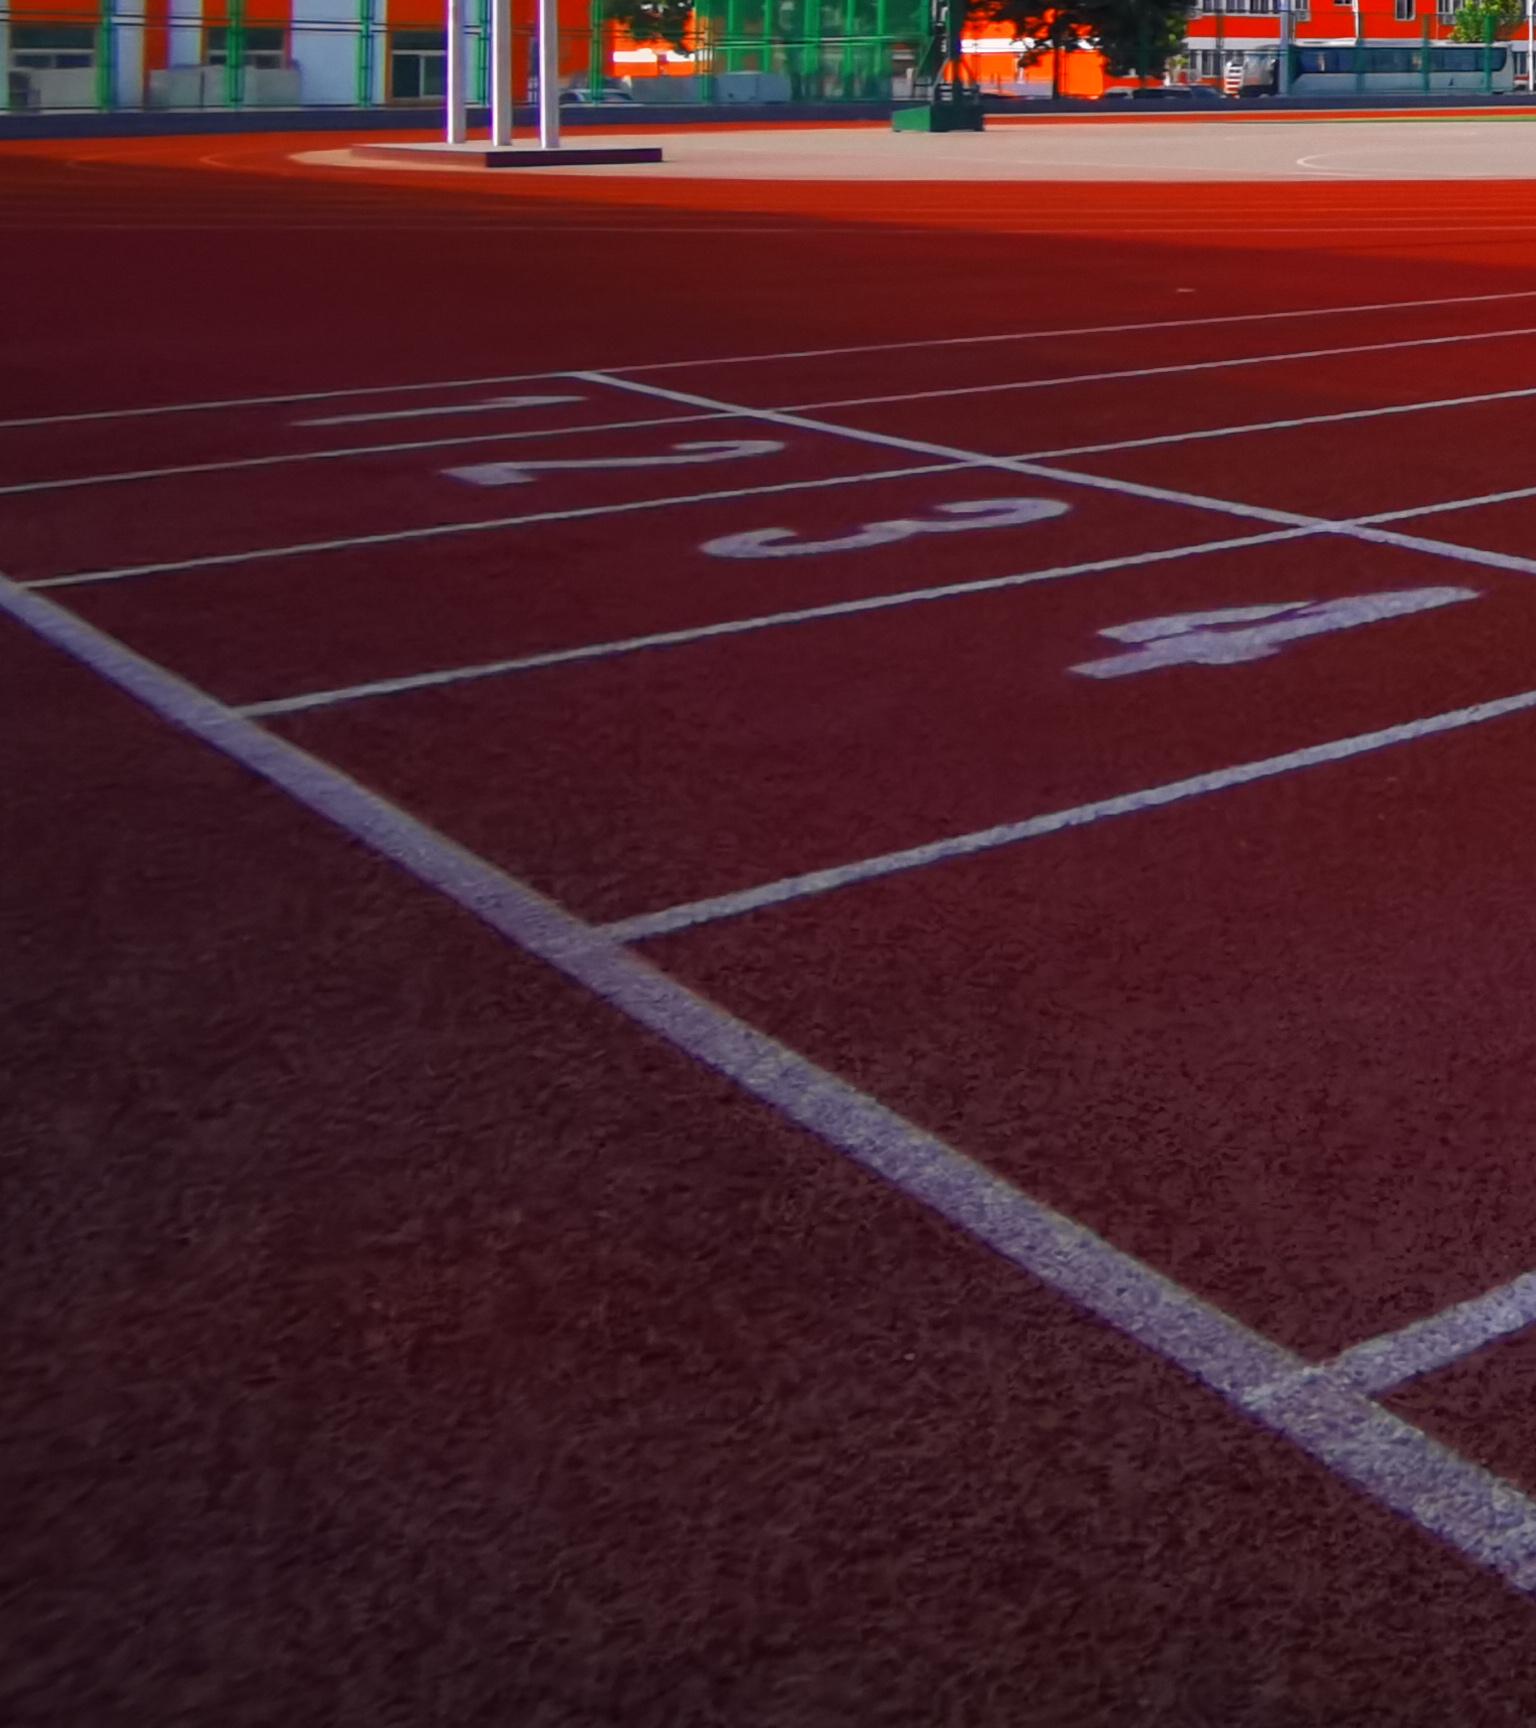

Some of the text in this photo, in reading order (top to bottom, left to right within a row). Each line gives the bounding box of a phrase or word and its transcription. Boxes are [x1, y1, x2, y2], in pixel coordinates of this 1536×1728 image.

[290, 394, 588, 427] 1
[440, 438, 787, 485] 2
[698, 496, 1070, 559] 3
[1068, 584, 1480, 680] 4
